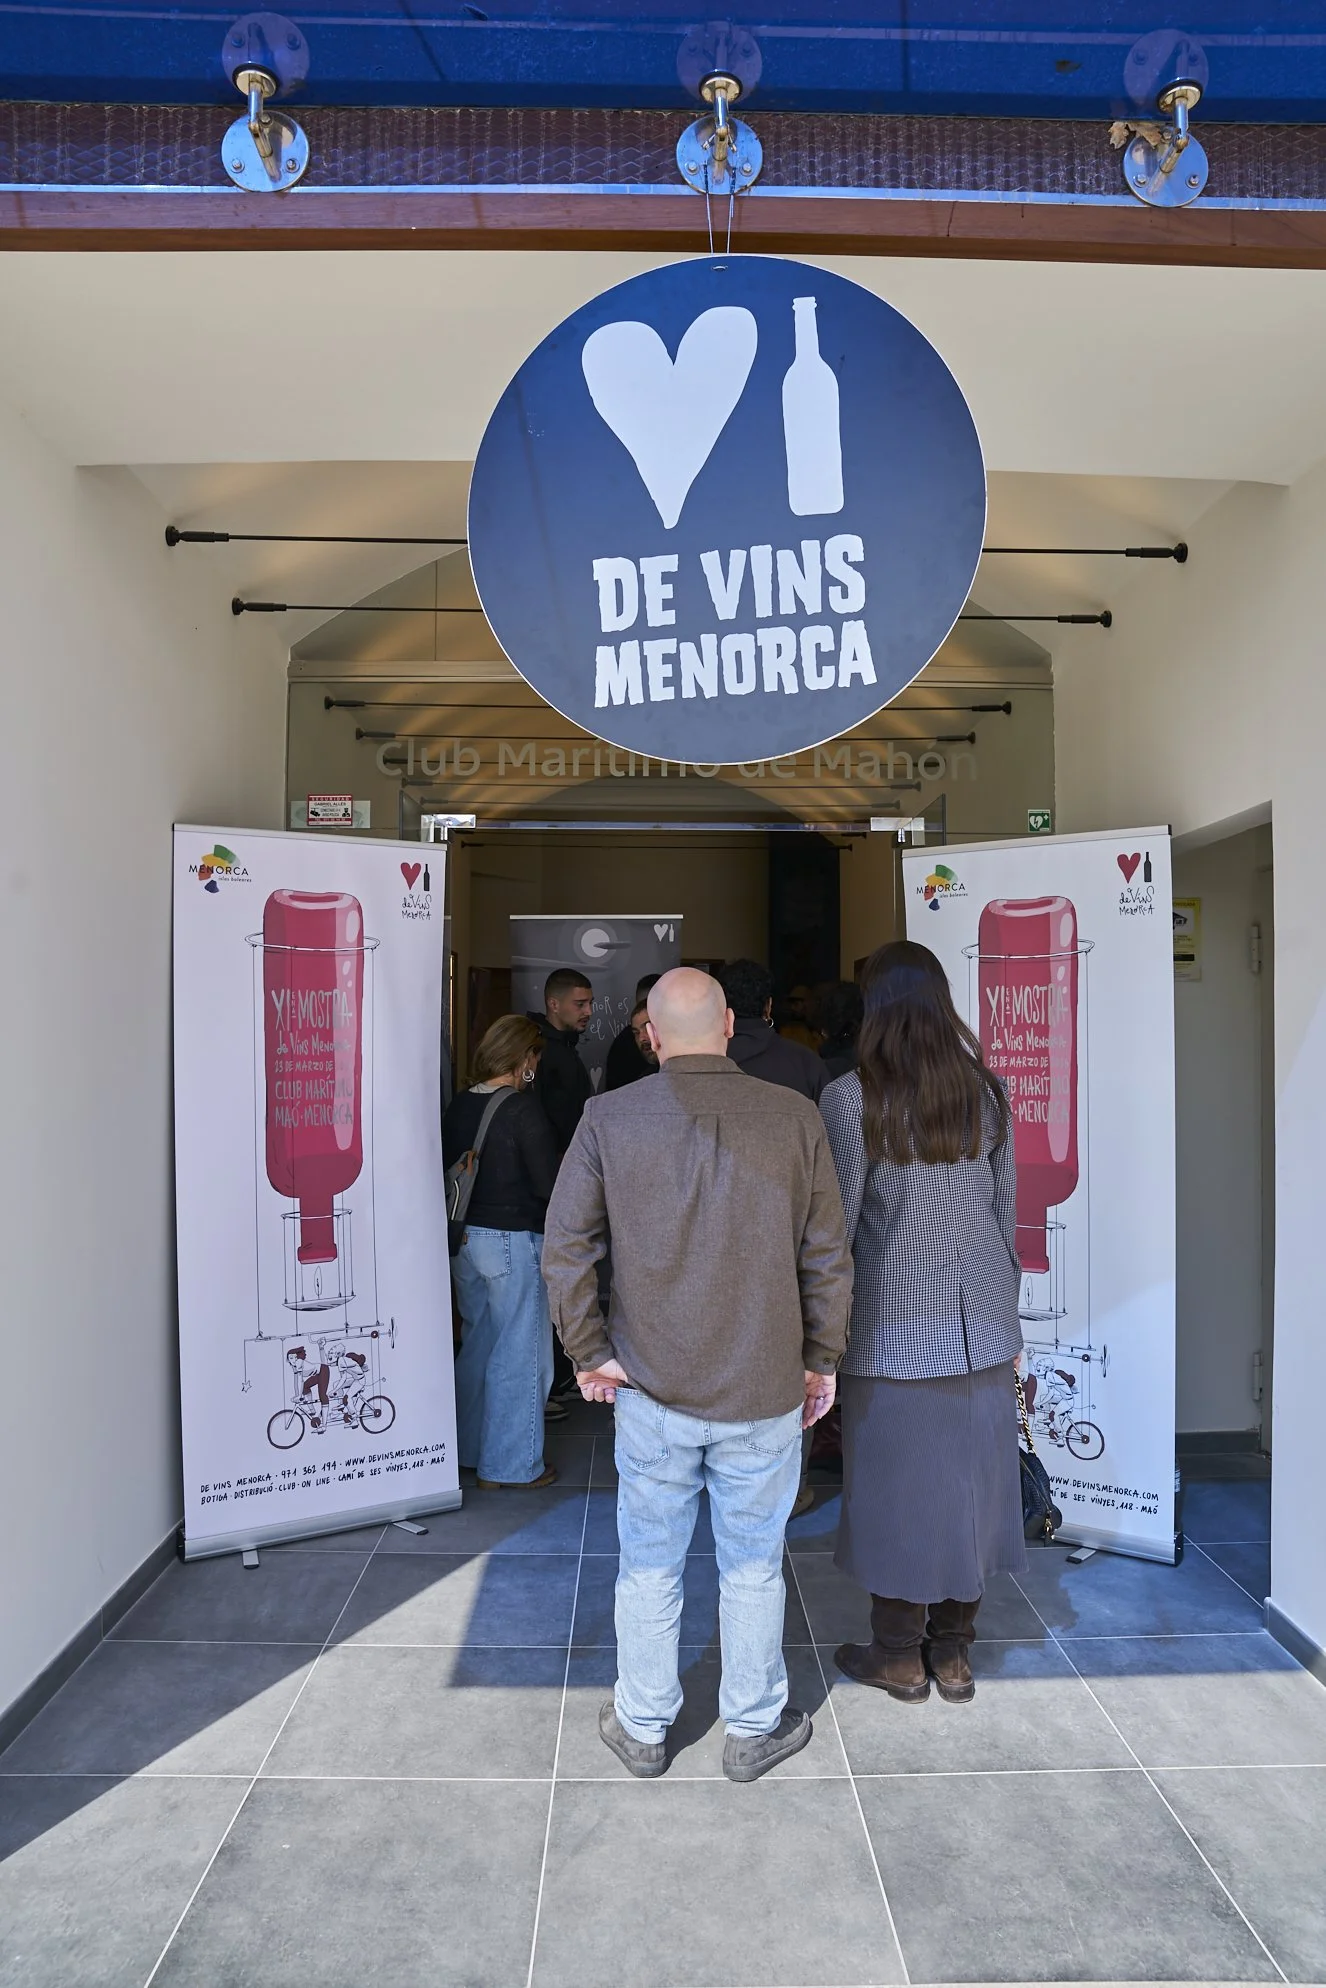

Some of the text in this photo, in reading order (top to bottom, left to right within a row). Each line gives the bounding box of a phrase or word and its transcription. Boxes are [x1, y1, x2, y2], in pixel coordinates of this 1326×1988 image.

[593, 534, 866, 633] DE VINS
[594, 619, 877, 708] MENORCA
[376, 738, 481, 776] Club
[814, 740, 978, 781] Mahón
[188, 864, 249, 876] MENORCA
[916, 883, 966, 894] MENORCA
[298, 988, 352, 1030] MOSTRA
[1012, 983, 1068, 1028] MOSTRA
[277, 1030, 288, 1054] de
[991, 1026, 1003, 1051] de
[285, 1060, 294, 1072] DE
[295, 1060, 324, 1072] MARZO
[326, 1060, 334, 1072] DE
[1000, 1056, 1008, 1068] DE
[1009, 1056, 1039, 1068] MARZO
[1041, 1056, 1049, 1068] DE
[276, 1080, 302, 1100] CLUB
[1019, 1071, 1070, 1097] MARÍTMO
[275, 1101, 353, 1128] MAÓ MENORCA
[200, 1442, 446, 1493] DE VINS MENORCA 971 362 194 WWW.DEVINSMENORCA.COM
[201, 1492, 228, 1505] BOTIGA
[234, 1482, 274, 1500] DISTRIBUCIÓ
[278, 1482, 296, 1492] CLUB
[301, 1480, 311, 1488] ON
[316, 1477, 331, 1486] LINE
[338, 1469, 356, 1482] CAMÍ
[370, 1467, 382, 1476] SES
[430, 1453, 446, 1465] MAÓ
[1060, 1491, 1068, 1499] DE
[1073, 1494, 1086, 1502] SES
[1140, 1505, 1159, 1514] MAÓ
